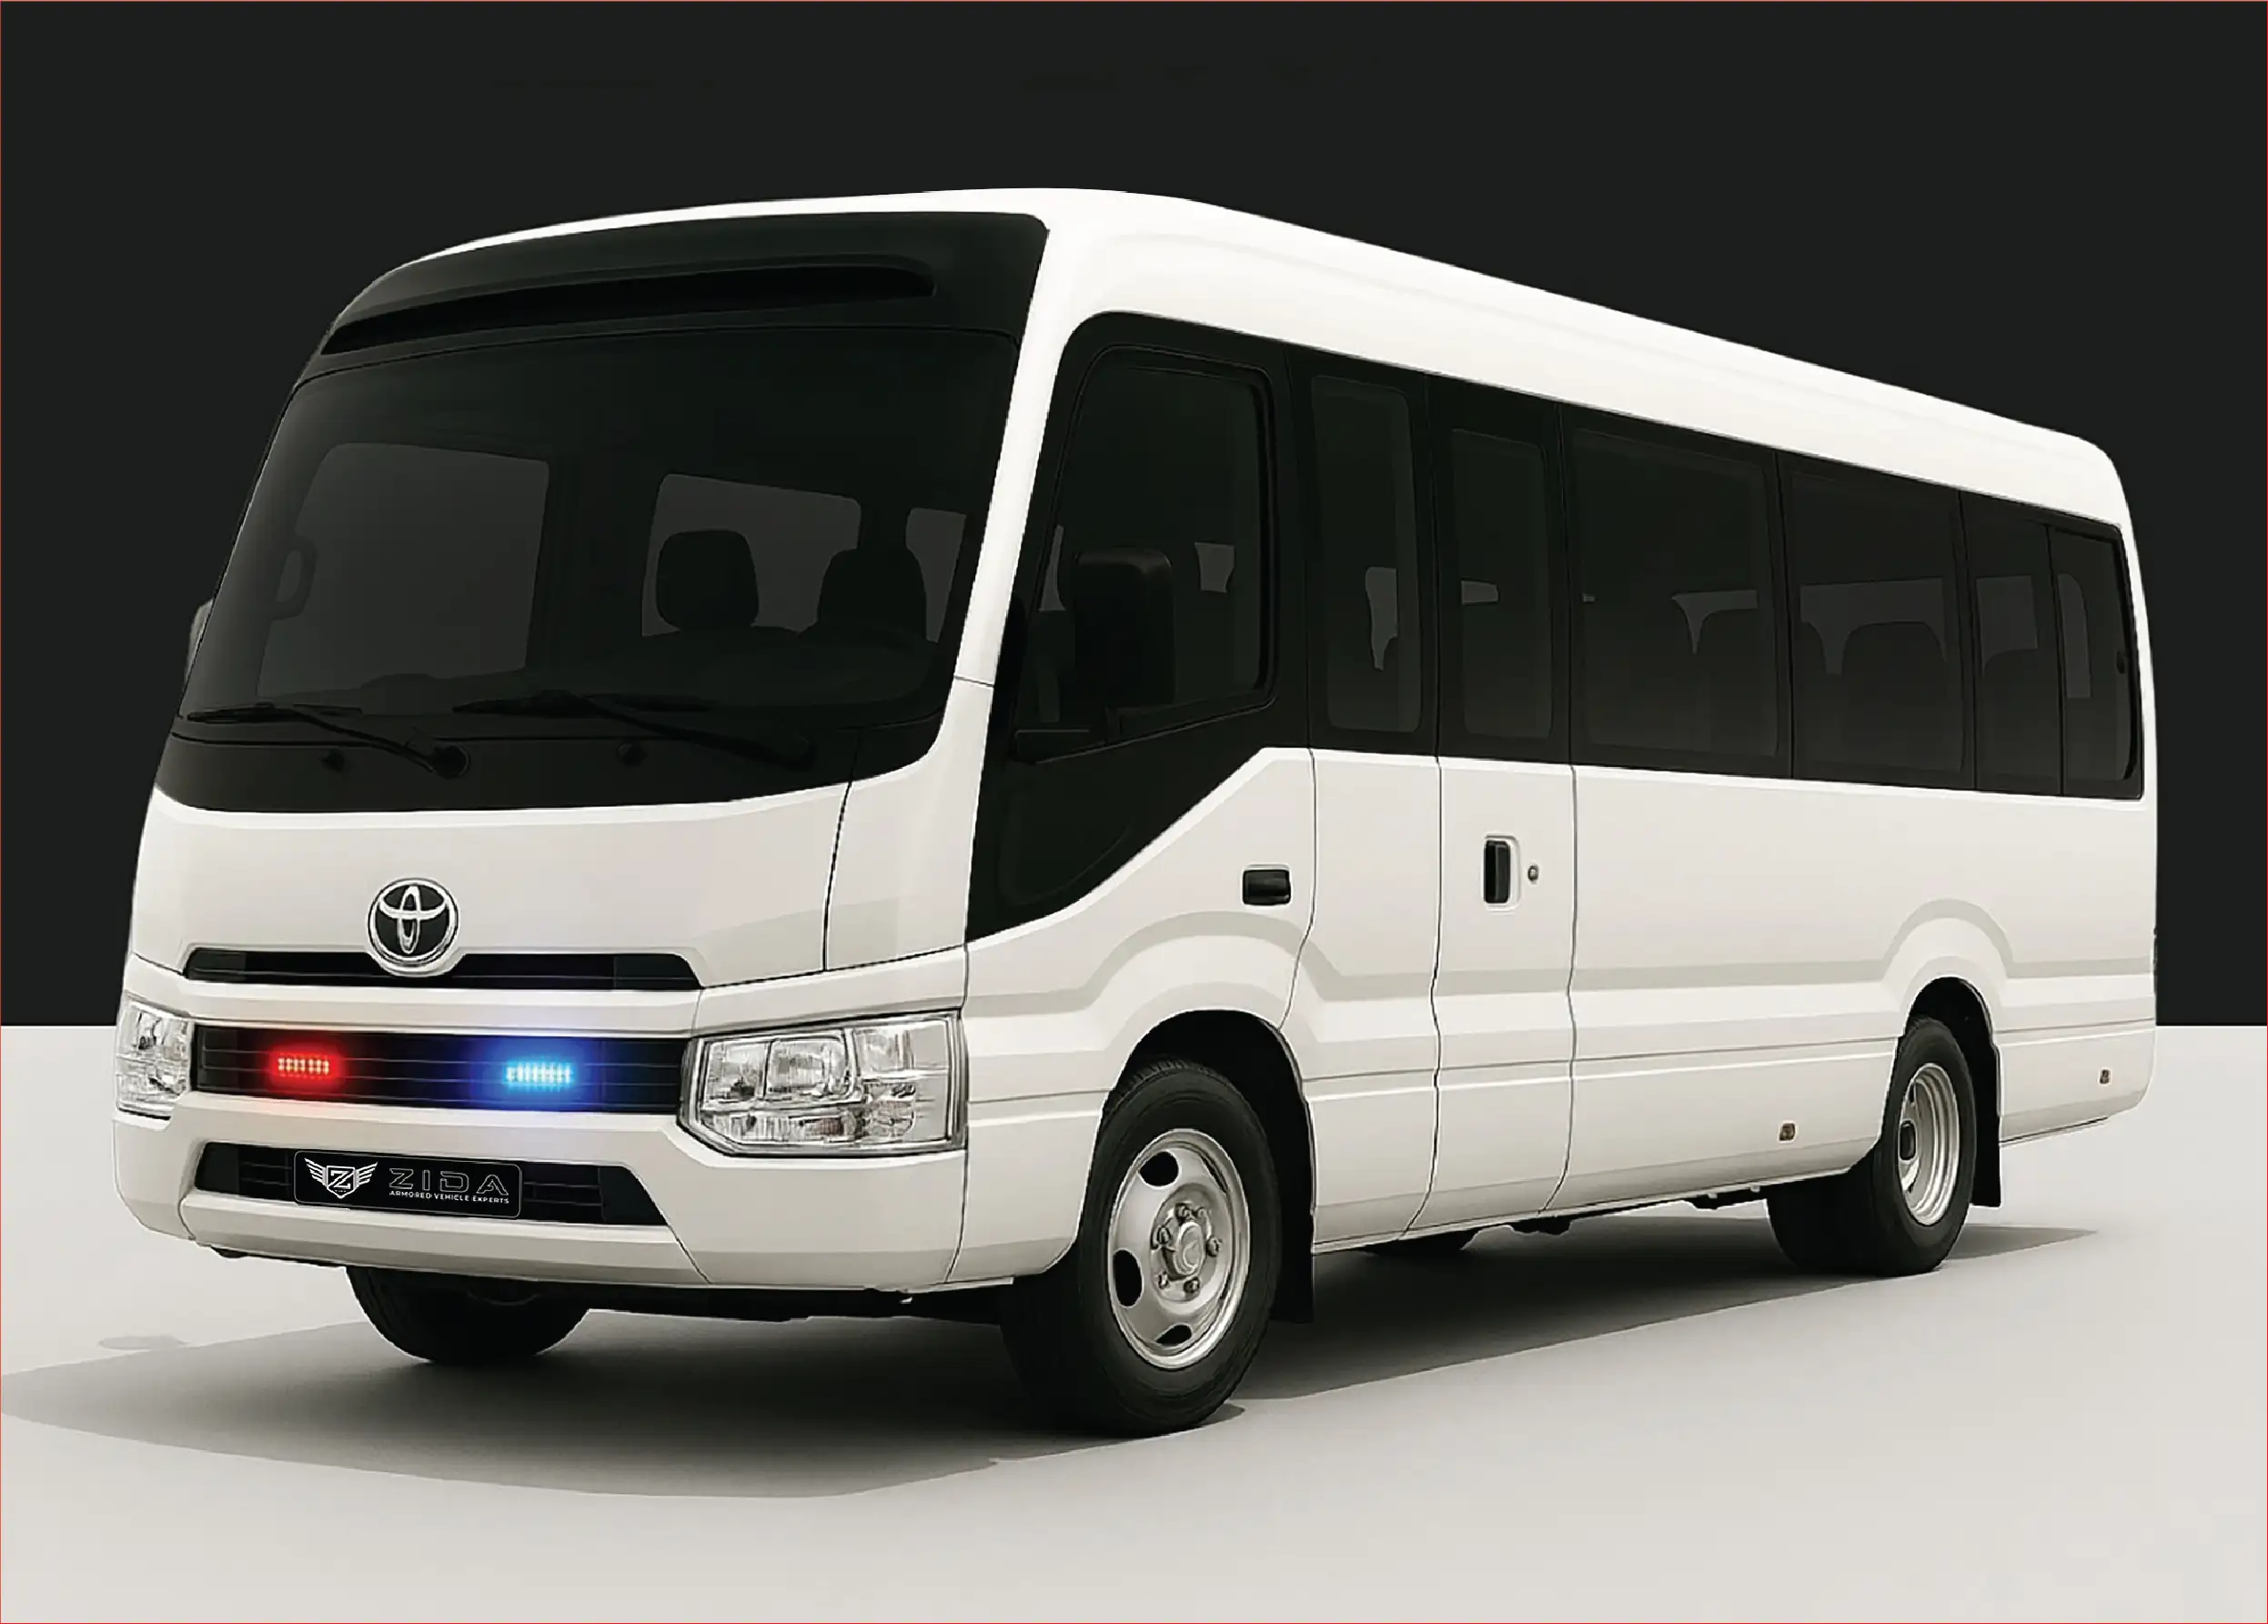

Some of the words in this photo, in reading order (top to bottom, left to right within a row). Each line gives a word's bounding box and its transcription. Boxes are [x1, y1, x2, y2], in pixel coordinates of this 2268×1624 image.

[388, 1167, 509, 1195] ZIDA
[388, 1190, 432, 1199] ARMORED
[433, 1193, 469, 1202] VEHICLE
[472, 1195, 509, 1204] EXPERTS
